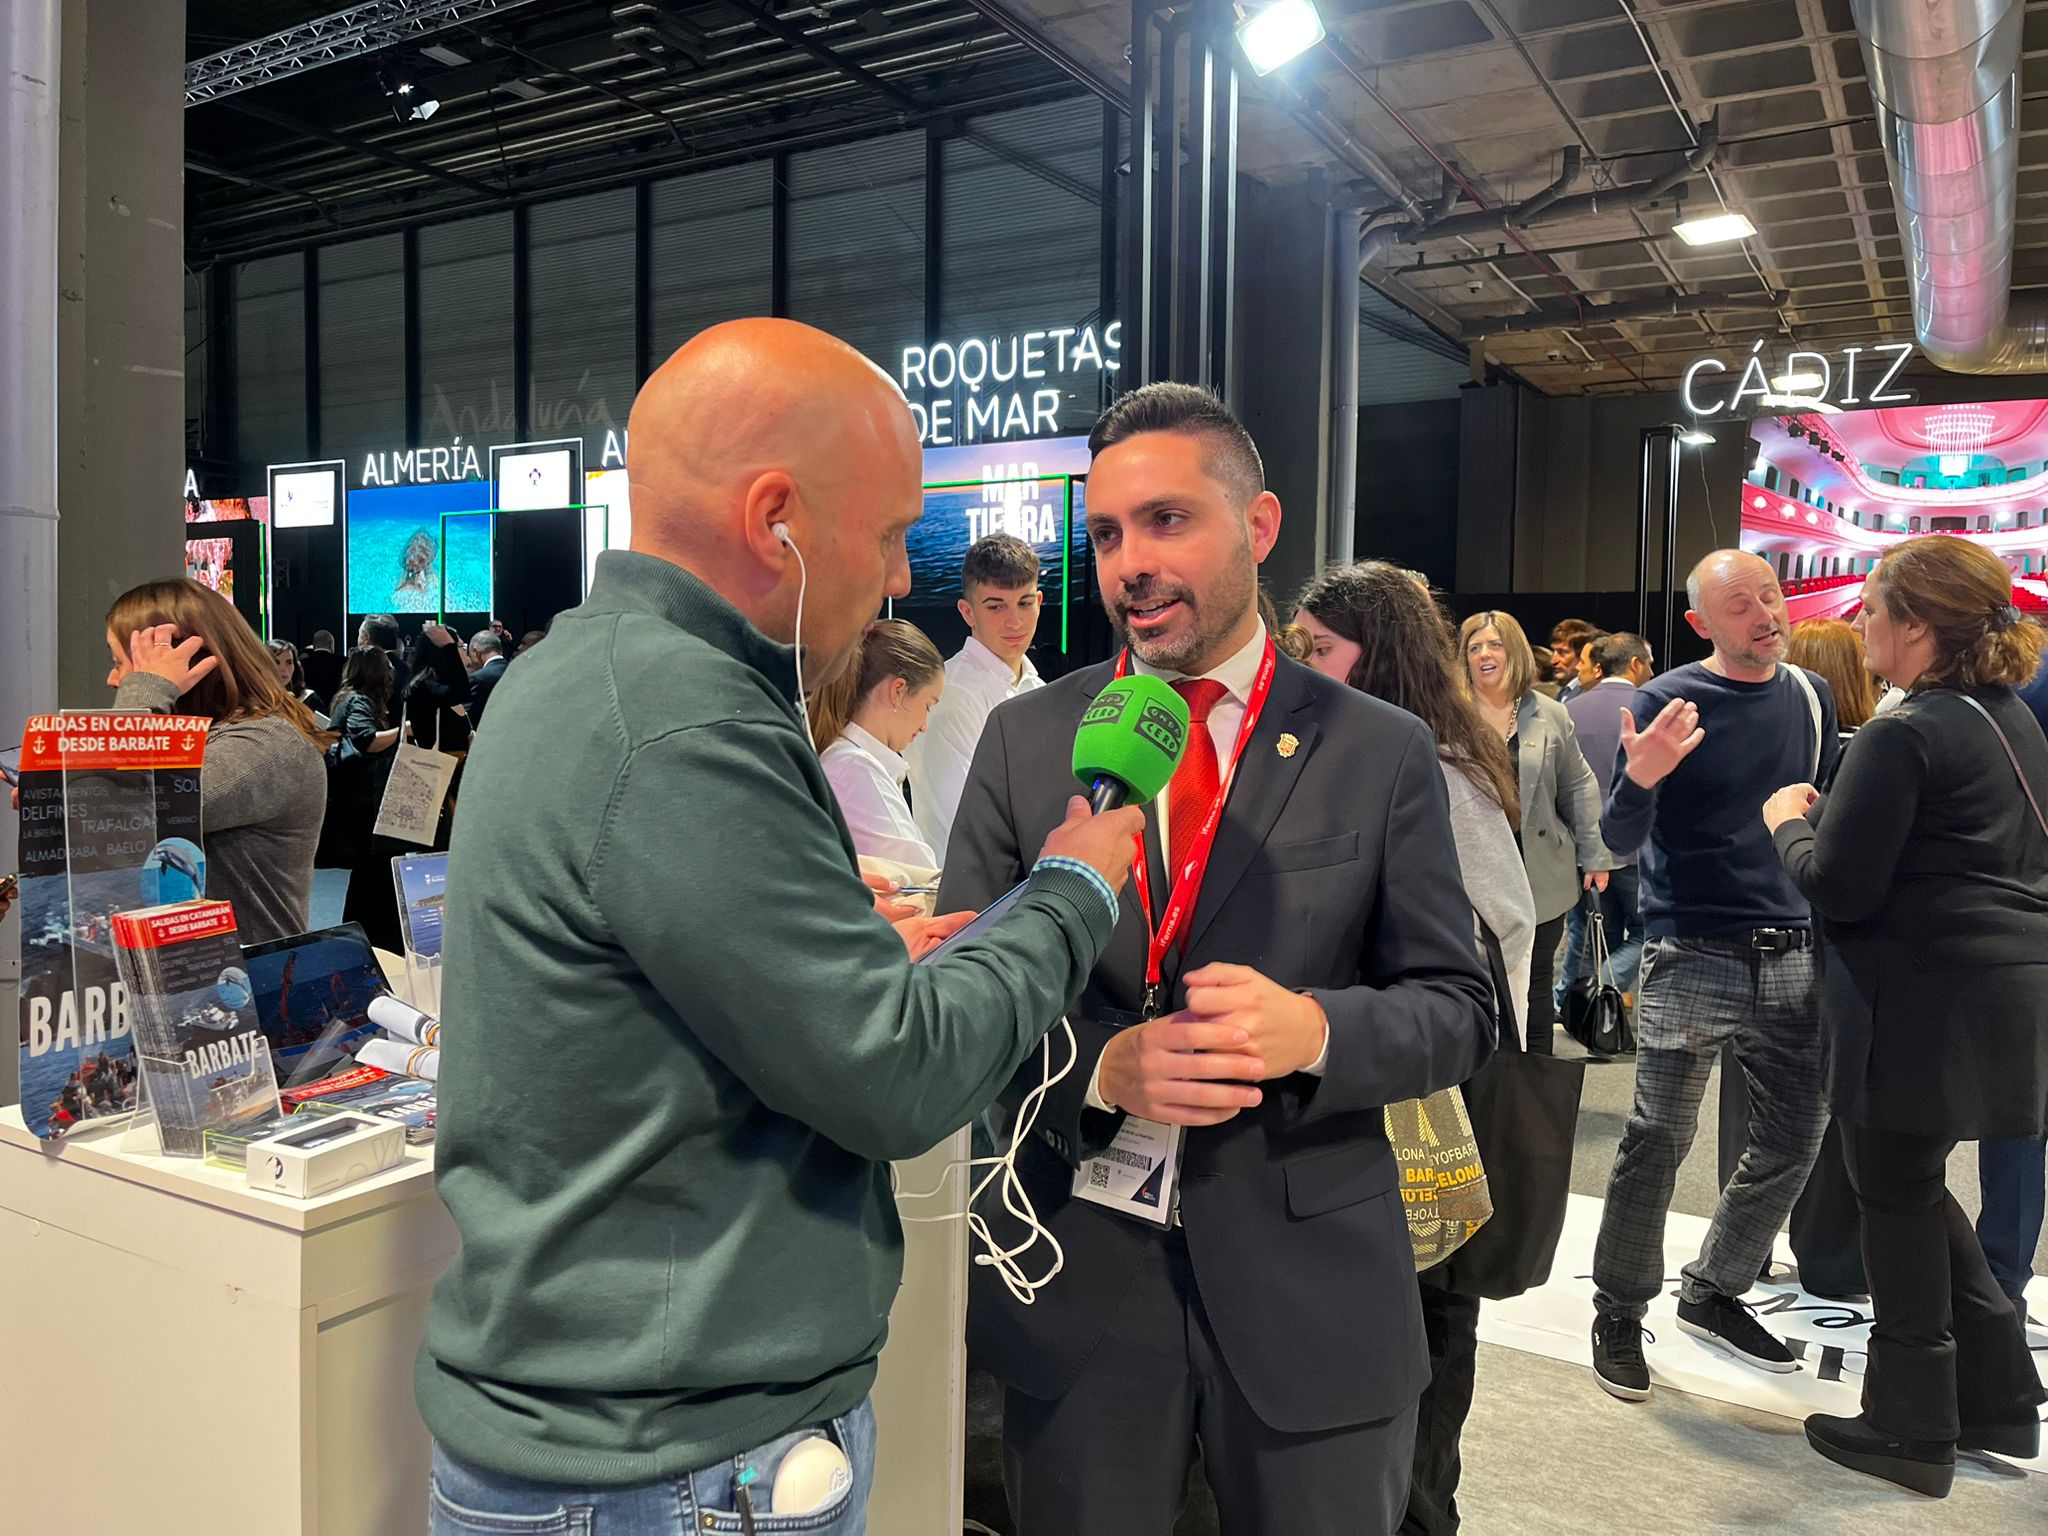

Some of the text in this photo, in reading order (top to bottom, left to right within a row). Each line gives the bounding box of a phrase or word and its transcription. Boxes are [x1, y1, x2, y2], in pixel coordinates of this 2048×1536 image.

[902, 321, 1121, 392] ROQUETAS
[1685, 339, 1913, 415] CÁDIZ
[907, 390, 1060, 444] DE MAR
[362, 434, 483, 487] ALMERÍA
[982, 461, 1040, 503] MAR
[965, 503, 1056, 546] TIERA
[28, 716, 212, 732] SALIDAS EN CATAMARÁN
[1147, 723, 1175, 750] CERO
[1151, 708, 1181, 736] ONDA
[58, 737, 170, 752] DESDE BARBATE
[174, 778, 200, 793] SOL
[22, 803, 88, 821] DELFINES
[81, 816, 158, 835] TRAFALGAR
[24, 846, 97, 863] ALMADRABA
[1160, 906, 1180, 947] ifema.es
[30, 982, 132, 1057] BARB
[186, 1030, 262, 1080] BARBATE
[1393, 1147, 1425, 1161] LONA
